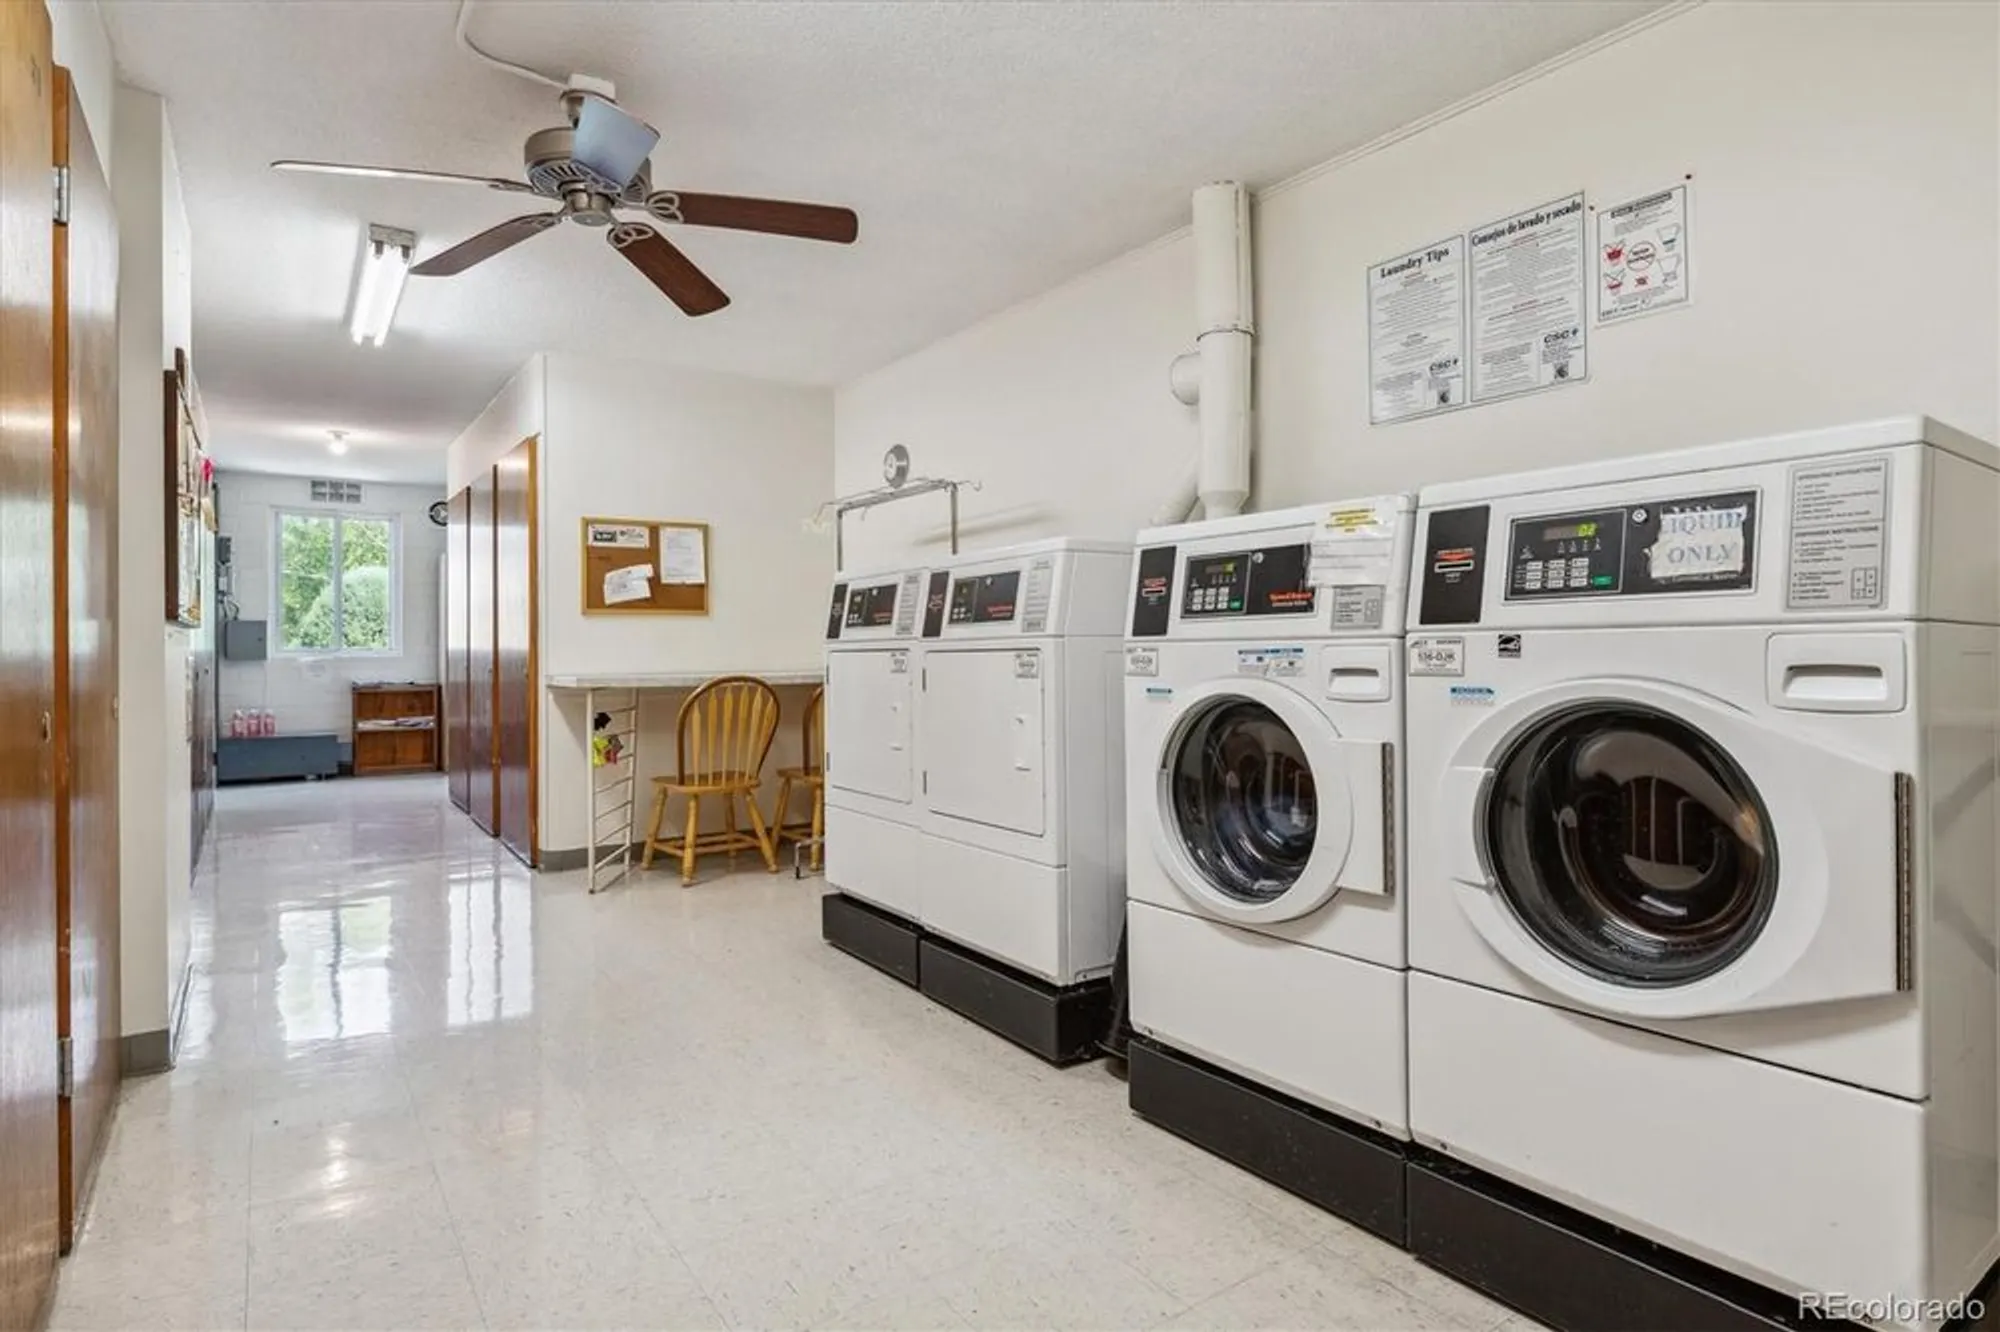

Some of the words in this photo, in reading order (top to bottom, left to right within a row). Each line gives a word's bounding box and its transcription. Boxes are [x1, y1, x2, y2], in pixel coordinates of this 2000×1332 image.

[1472, 227, 1506, 247] Consejos
[1507, 221, 1518, 235] de
[1518, 213, 1545, 231] lavado
[1552, 200, 1582, 219] secado
[1380, 257, 1422, 278] Laundry
[1425, 247, 1449, 263] Tips
[1667, 542, 1738, 564] ONLY
